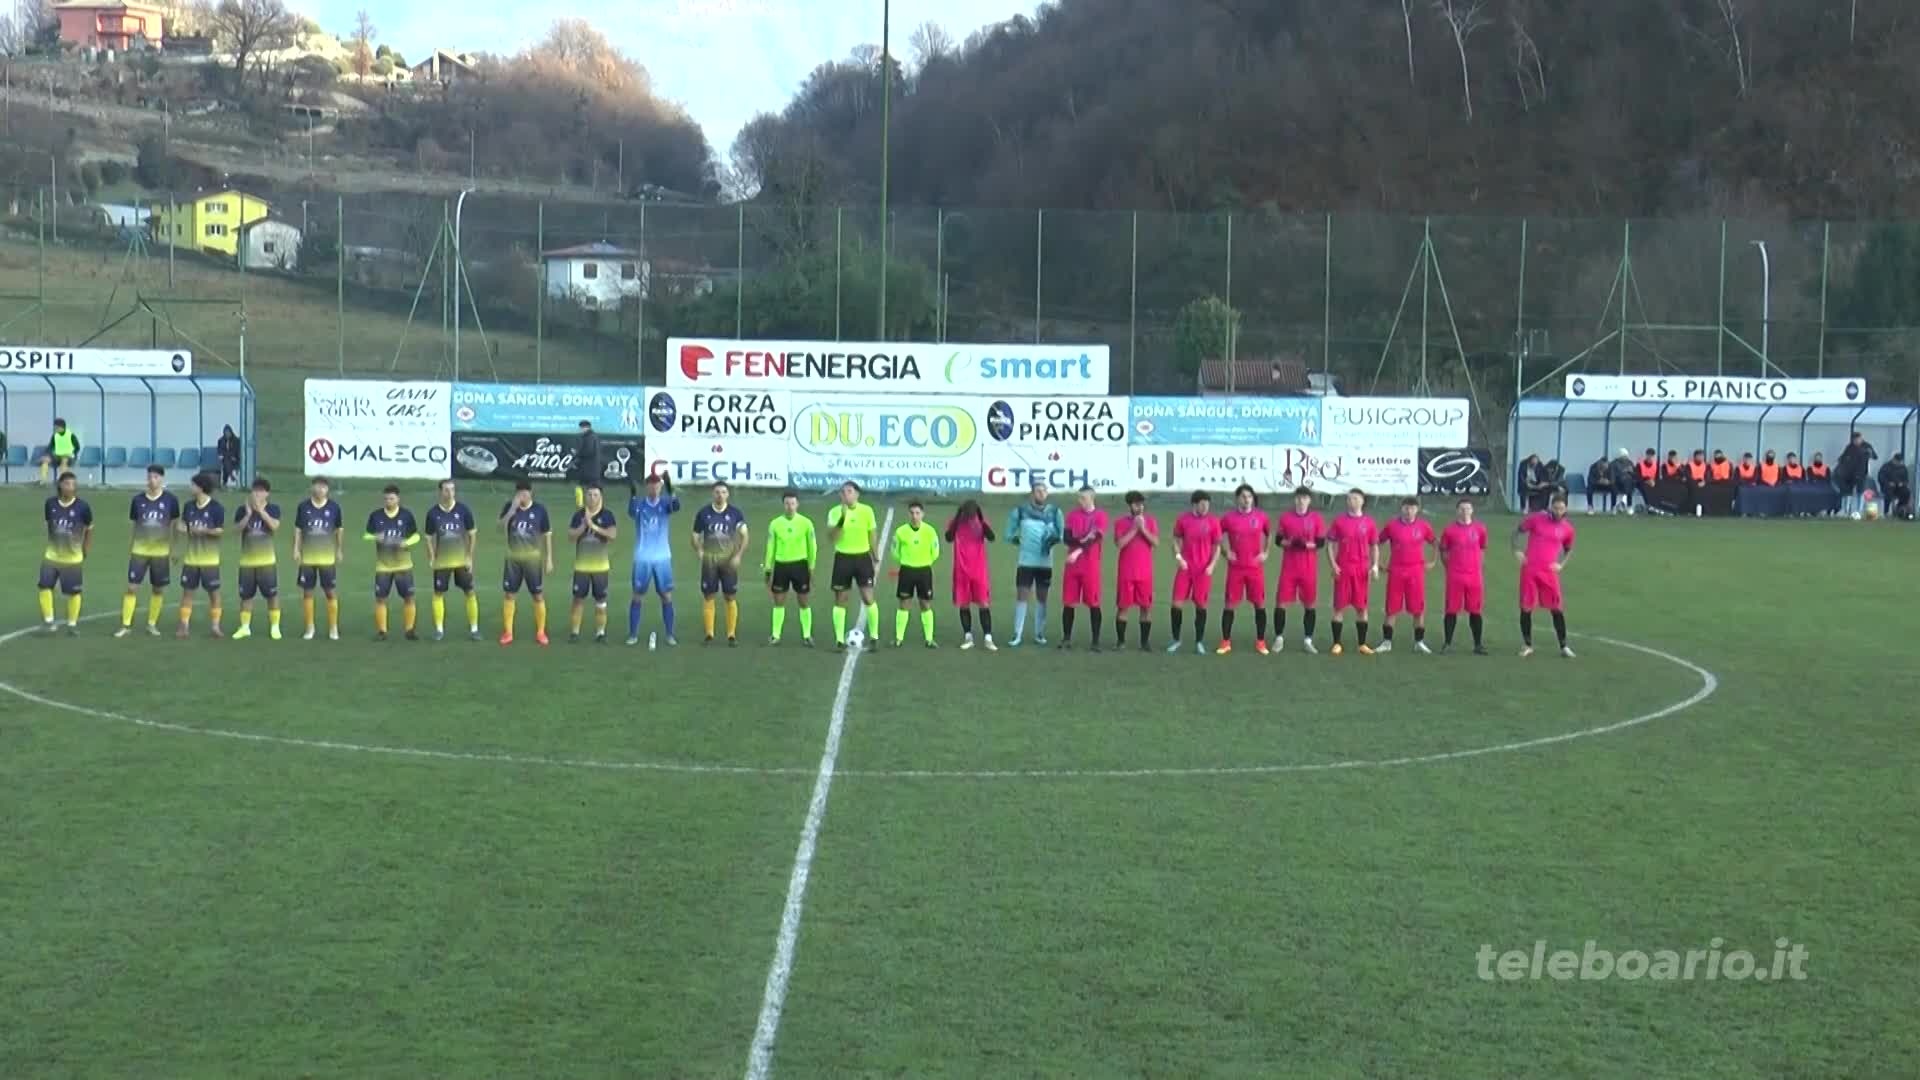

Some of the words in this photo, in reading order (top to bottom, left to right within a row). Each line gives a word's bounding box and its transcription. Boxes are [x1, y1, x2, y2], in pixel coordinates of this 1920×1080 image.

[725, 351, 921, 380] FENENERGIA
[980, 353, 1091, 380] smart
[453, 390, 495, 405] DONA
[562, 392, 604, 406] DONA
[606, 393, 640, 407] VITA
[1631, 379, 1676, 398] U.S.
[1685, 380, 1787, 400] PIANICO
[386, 403, 427, 418] CARS
[694, 393, 776, 414] FORZA
[1031, 401, 1113, 420] FORZA
[1133, 405, 1175, 418] DONA
[1241, 405, 1283, 418] DONA
[1284, 405, 1319, 418] VITA
[681, 415, 787, 435] PIANICO
[1335, 407, 1464, 426] BUSIGROUP
[809, 411, 958, 448] DU.ECO
[1019, 422, 1125, 441] PIANICO
[338, 444, 448, 463] MALECO
[988, 467, 1089, 488] GTECH
